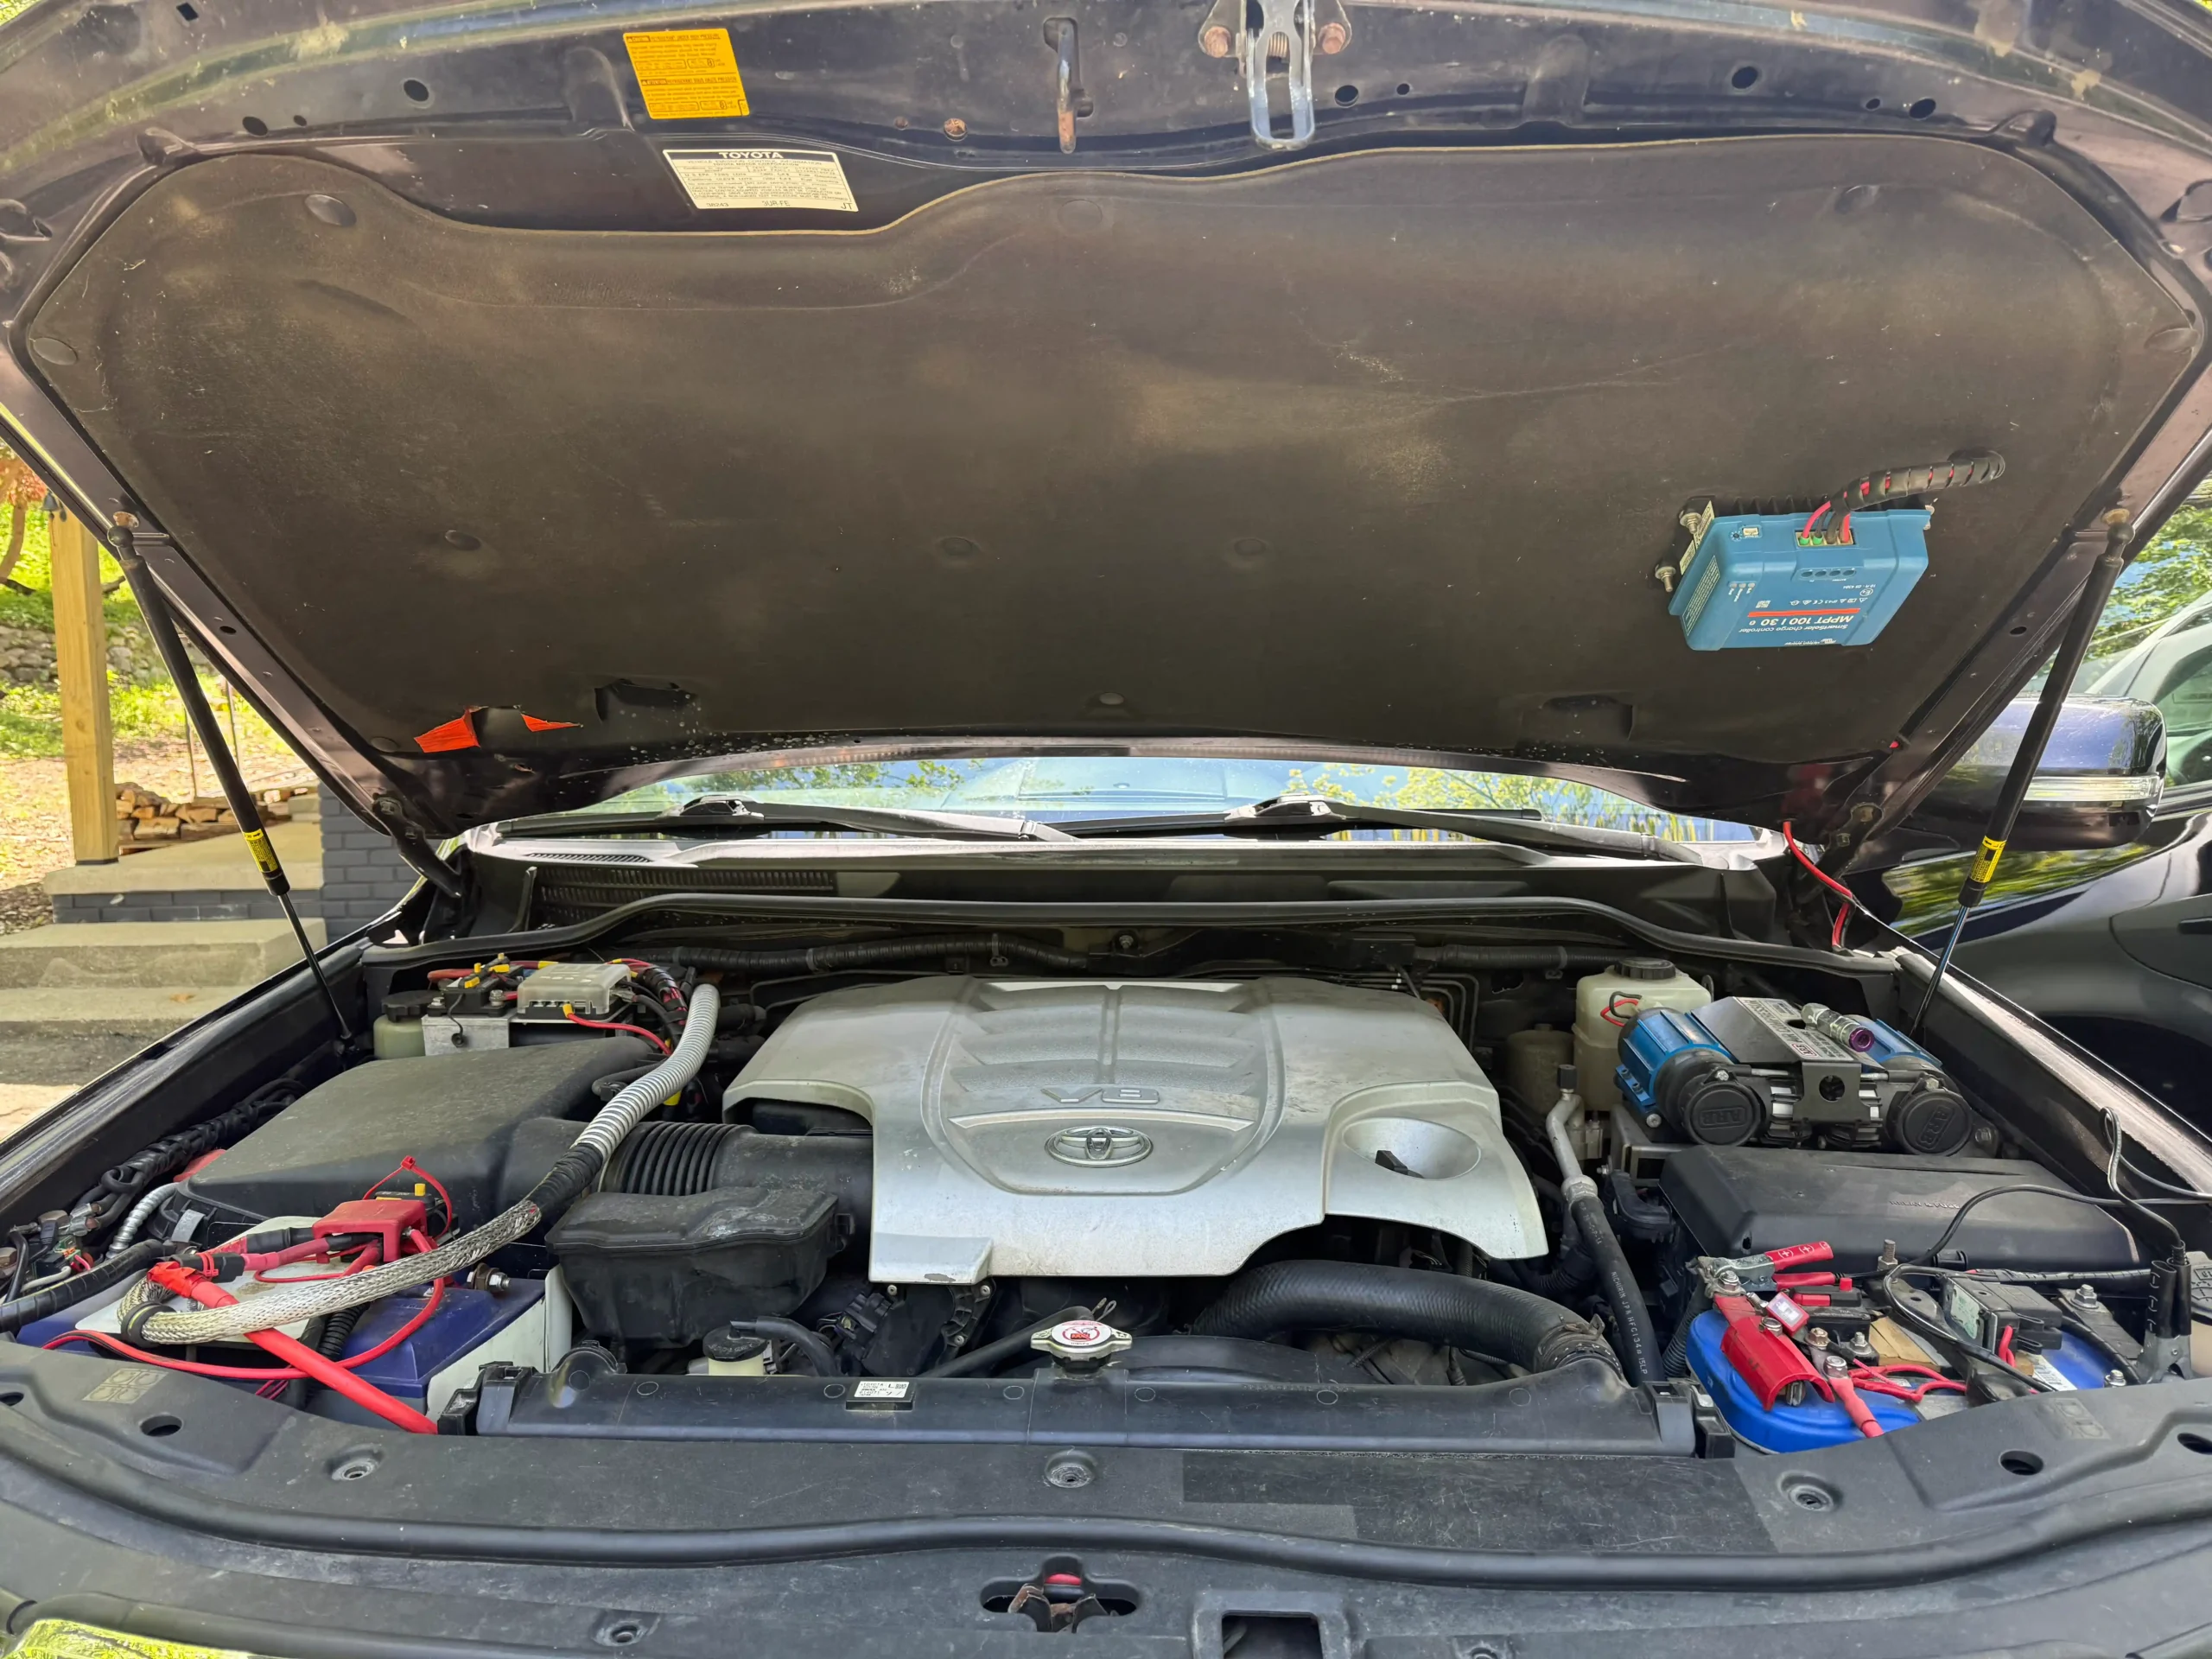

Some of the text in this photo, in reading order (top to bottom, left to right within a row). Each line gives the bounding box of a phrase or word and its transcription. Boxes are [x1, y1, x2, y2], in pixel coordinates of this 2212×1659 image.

[1814, 614, 1854, 624] MPPT
[1040, 1086, 1160, 1103] V8
[1700, 1108, 1745, 1127] ARB
[1919, 1107, 1953, 1147] ARB
